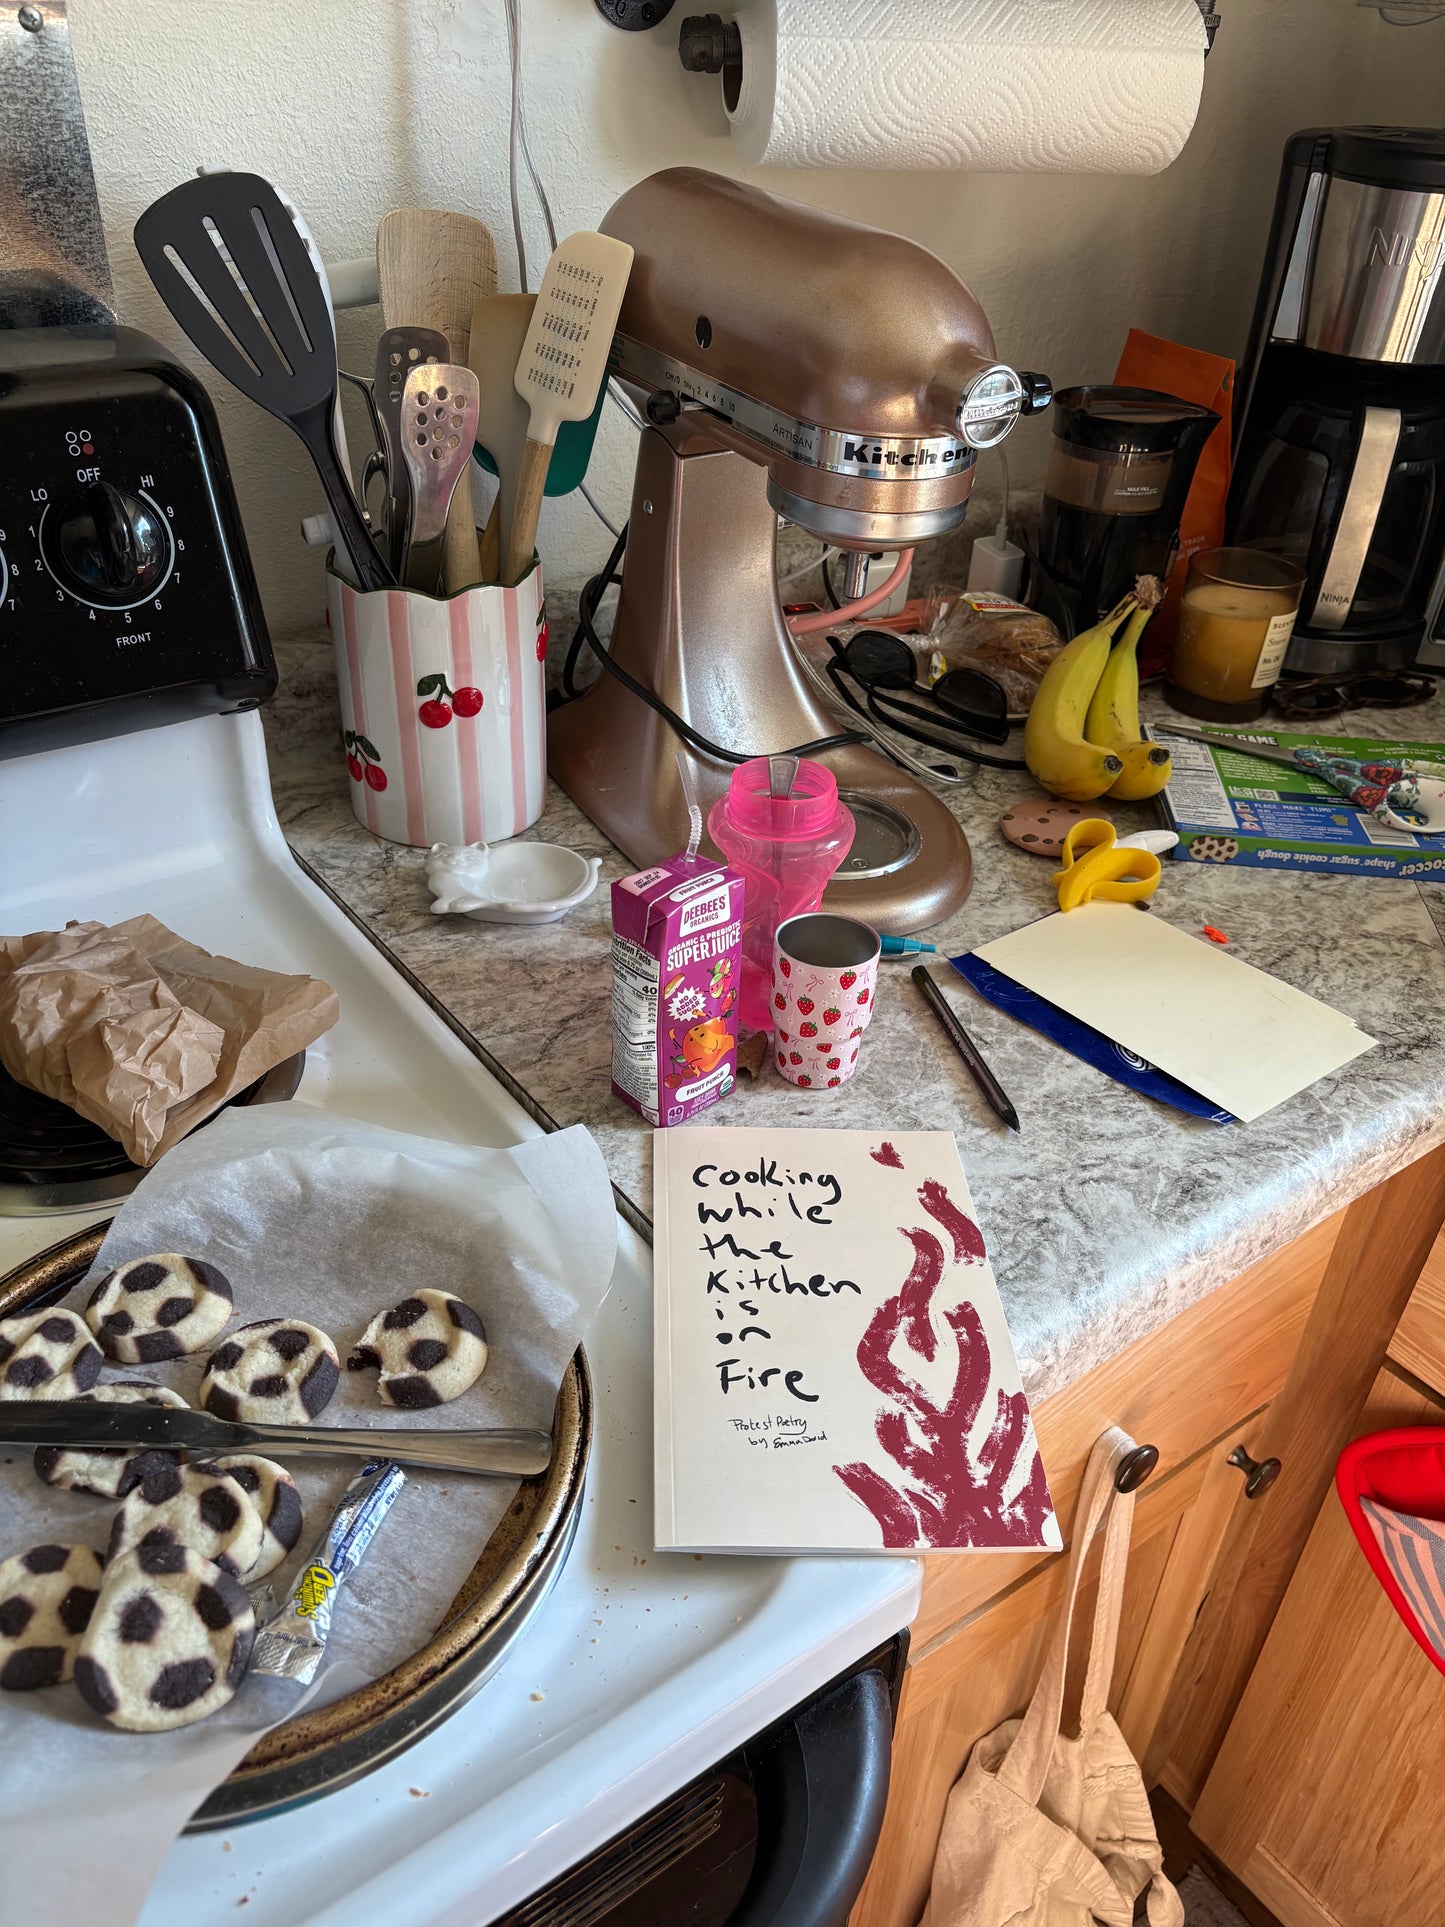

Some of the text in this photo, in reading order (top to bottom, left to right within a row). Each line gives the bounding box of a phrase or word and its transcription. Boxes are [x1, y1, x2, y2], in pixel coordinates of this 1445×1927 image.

[773, 423, 813, 450] ARTISAN
[76, 467, 101, 483] OFF
[140, 475, 155, 488] HI
[31, 487, 48, 502] LO
[166, 506, 175, 518] 9
[28, 525, 36, 538] 1
[177, 540, 185, 551] 8
[11, 564, 19, 576] 8
[34, 559, 43, 571] 2
[174, 573, 181, 584] 7
[56, 590, 65, 602] 3
[1320, 592, 1350, 606] NINJA
[8, 599, 15, 611] 7
[154, 599, 162, 611] 6
[88, 609, 96, 621] 4
[124, 612, 132, 624] 5
[116, 632, 152, 647] FRONT
[1256, 850, 1291, 862] dough
[1292, 853, 1328, 864] cookie
[1329, 854, 1361, 866] sugar
[678, 877, 716, 897] FRUIT PUNCH
[684, 894, 727, 925] DEEBEE'S
[689, 911, 719, 928] ORGANICS
[668, 936, 699, 956] ORGANIC
[706, 919, 742, 941] PREBIOTIC
[667, 926, 741, 972] SUPER JUICE
[635, 949, 652, 967] Facts
[642, 985, 658, 995] 40
[676, 995, 698, 1012] ADDED
[679, 995, 689, 1005] NO
[677, 1000, 701, 1017] SUGAR
[686, 1082, 706, 1096] FRUIT
[705, 1070, 724, 1087] PUNCH
[669, 1107, 683, 1117] 40
[698, 1192, 833, 1225] while
[699, 1233, 794, 1261] the
[715, 1300, 759, 1321] is
[715, 1326, 772, 1345] on
[716, 1357, 820, 1402] Fire
[727, 1414, 807, 1436] Protest Poetry
[748, 1437, 768, 1449] by
[292, 1633, 310, 1648] Tear
